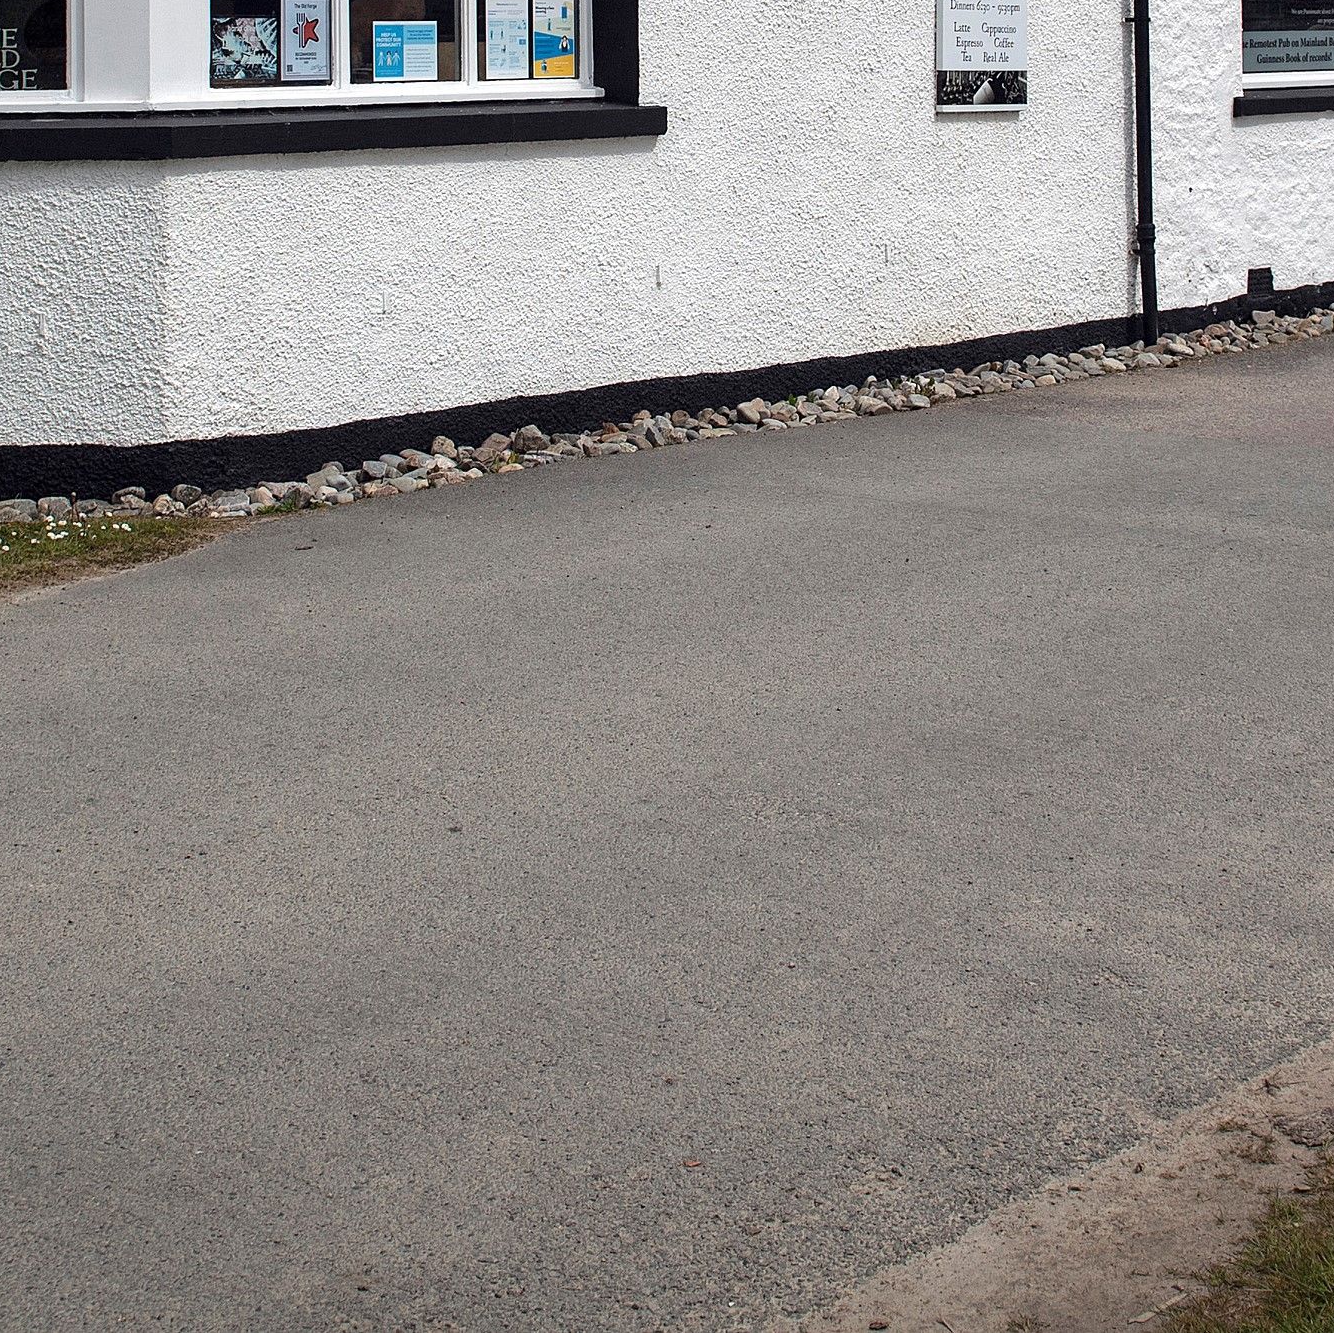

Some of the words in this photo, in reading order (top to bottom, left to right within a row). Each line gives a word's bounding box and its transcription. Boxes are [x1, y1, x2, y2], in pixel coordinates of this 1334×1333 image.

[950, 0, 975, 11] Dinners
[954, 22, 971, 32] Latte
[982, 22, 1016, 37] Cappuccino
[956, 37, 983, 50] Espresso
[994, 38, 1014, 48] Coffee
[1250, 38, 1276, 48] Remotest
[1279, 38, 1289, 47] Pub
[1301, 37, 1327, 47] Mainland
[961, 51, 971, 62] Tea
[983, 52, 996, 62] Real
[998, 52, 1009, 62] Ale
[1257, 53, 1284, 64] Guinness
[1286, 53, 1300, 63] Book
[1302, 52, 1309, 62] of
